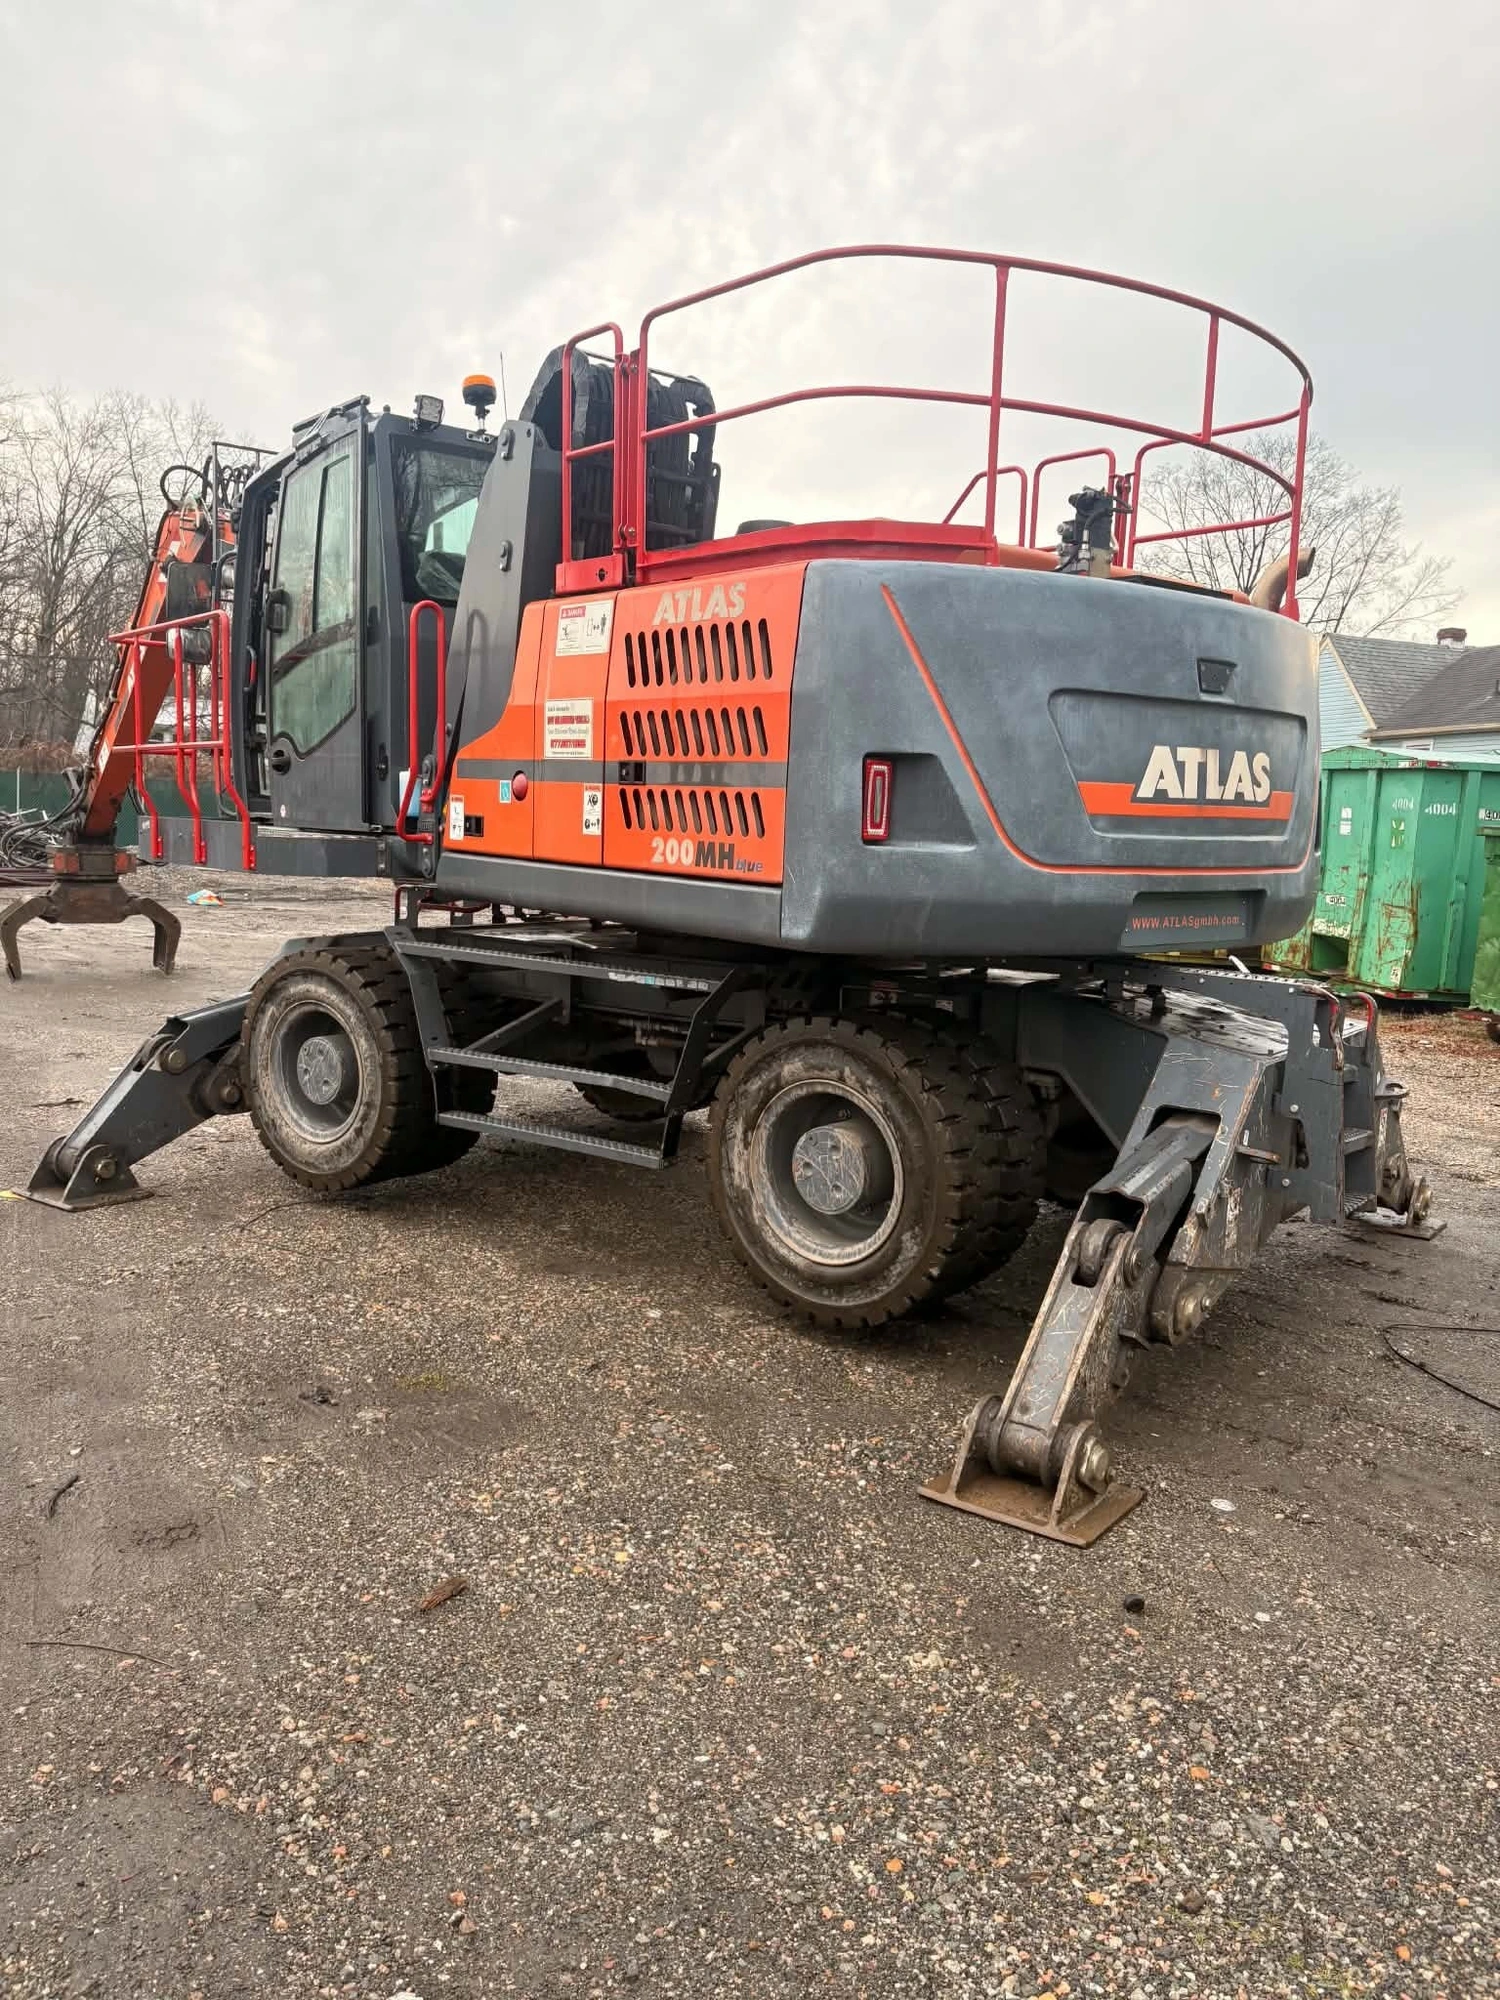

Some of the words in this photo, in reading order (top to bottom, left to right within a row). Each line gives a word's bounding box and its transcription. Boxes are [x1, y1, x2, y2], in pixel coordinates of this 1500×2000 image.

[652, 582, 746, 626] ATLAS
[1136, 745, 1271, 803] ATLAS
[1392, 797, 1414, 811] 4004
[1424, 802, 1457, 816] 4004
